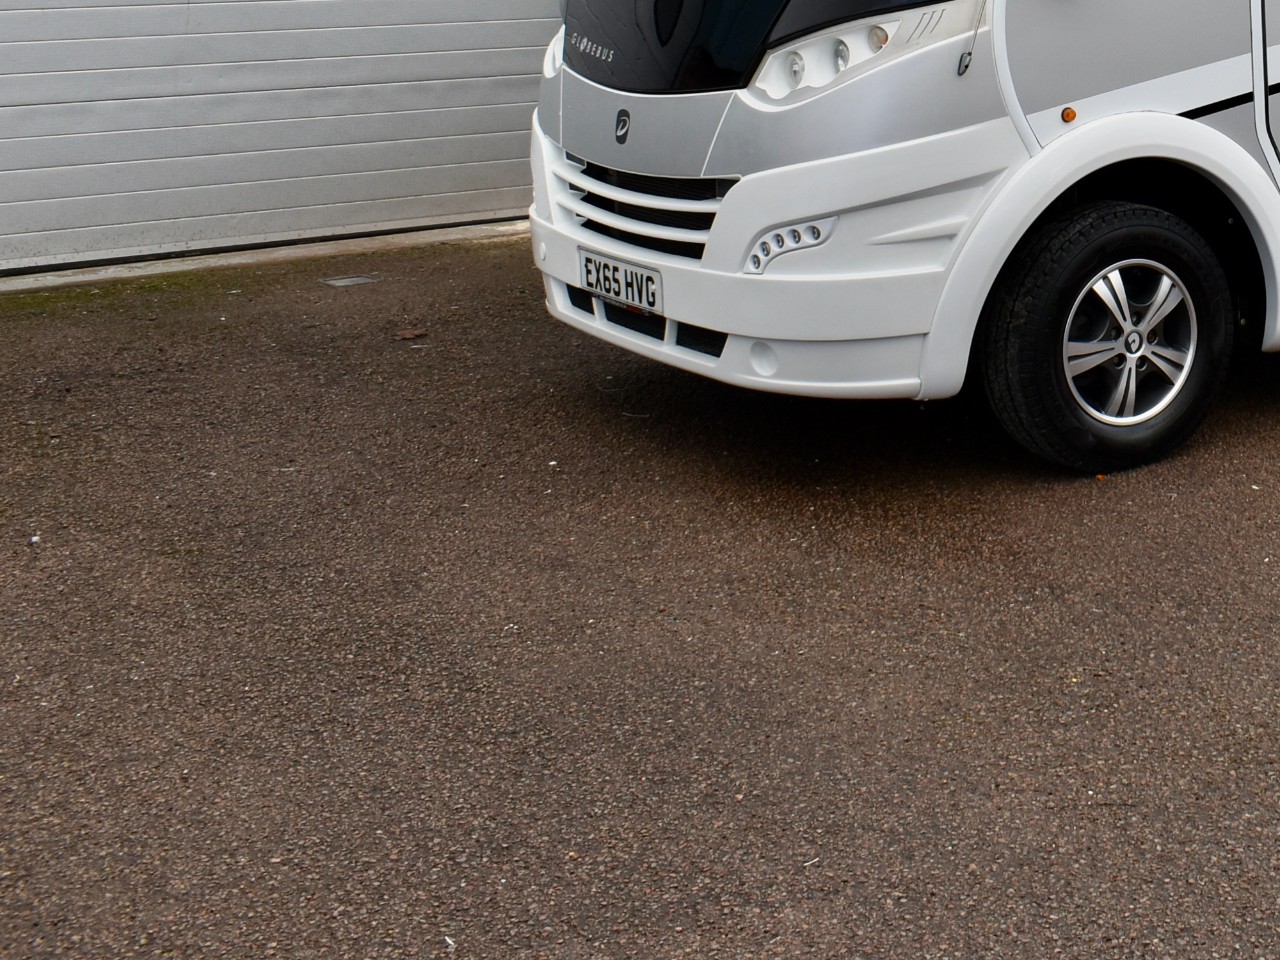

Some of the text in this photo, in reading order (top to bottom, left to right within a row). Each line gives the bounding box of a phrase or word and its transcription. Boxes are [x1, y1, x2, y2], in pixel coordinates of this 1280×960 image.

[571, 32, 615, 62] GLOBEBUS
[584, 256, 621, 298] EX65
[624, 268, 657, 308] HVG
